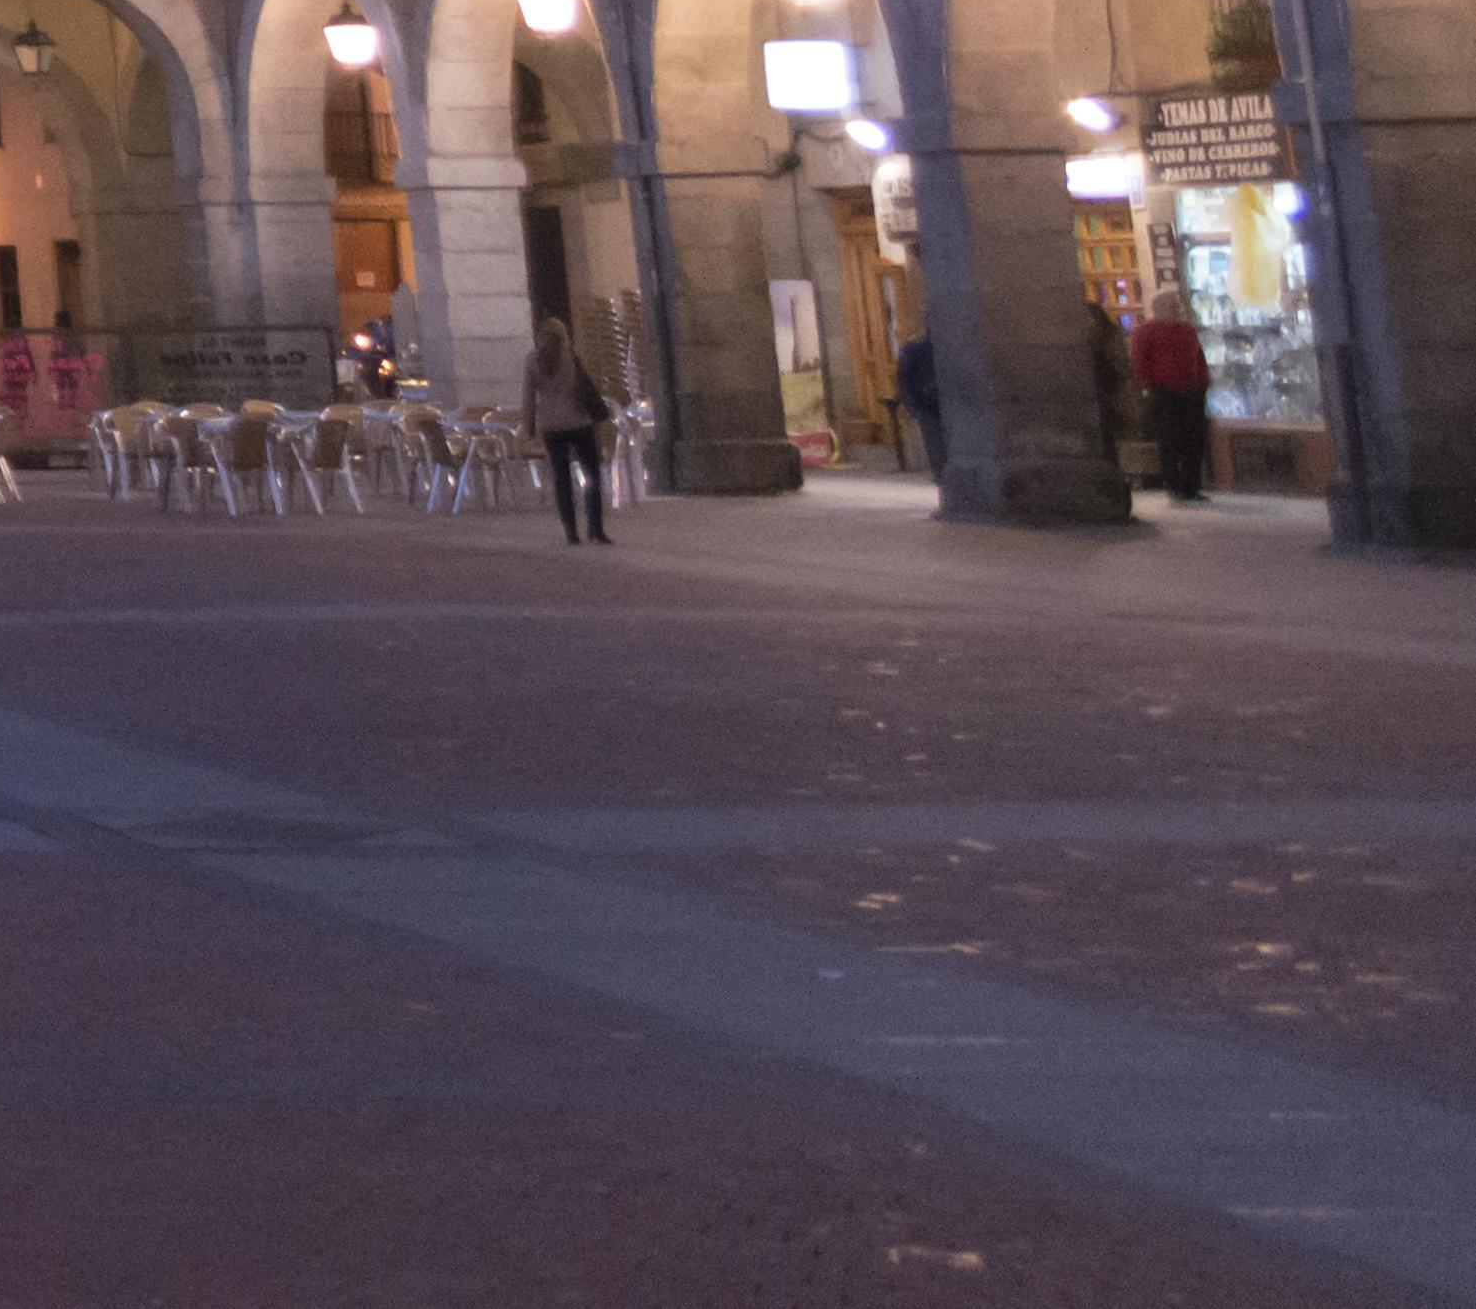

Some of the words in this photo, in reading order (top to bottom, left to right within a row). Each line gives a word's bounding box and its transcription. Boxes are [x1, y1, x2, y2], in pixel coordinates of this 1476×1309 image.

[1161, 99, 1206, 127] YEMAS
[1208, 97, 1228, 123] DE
[1200, 127, 1225, 143] DEL
[1228, 123, 1272, 141] BARCO
[1154, 148, 1185, 163] VINO
[1188, 146, 1205, 162] DE
[1165, 165, 1211, 182] PASTAS
